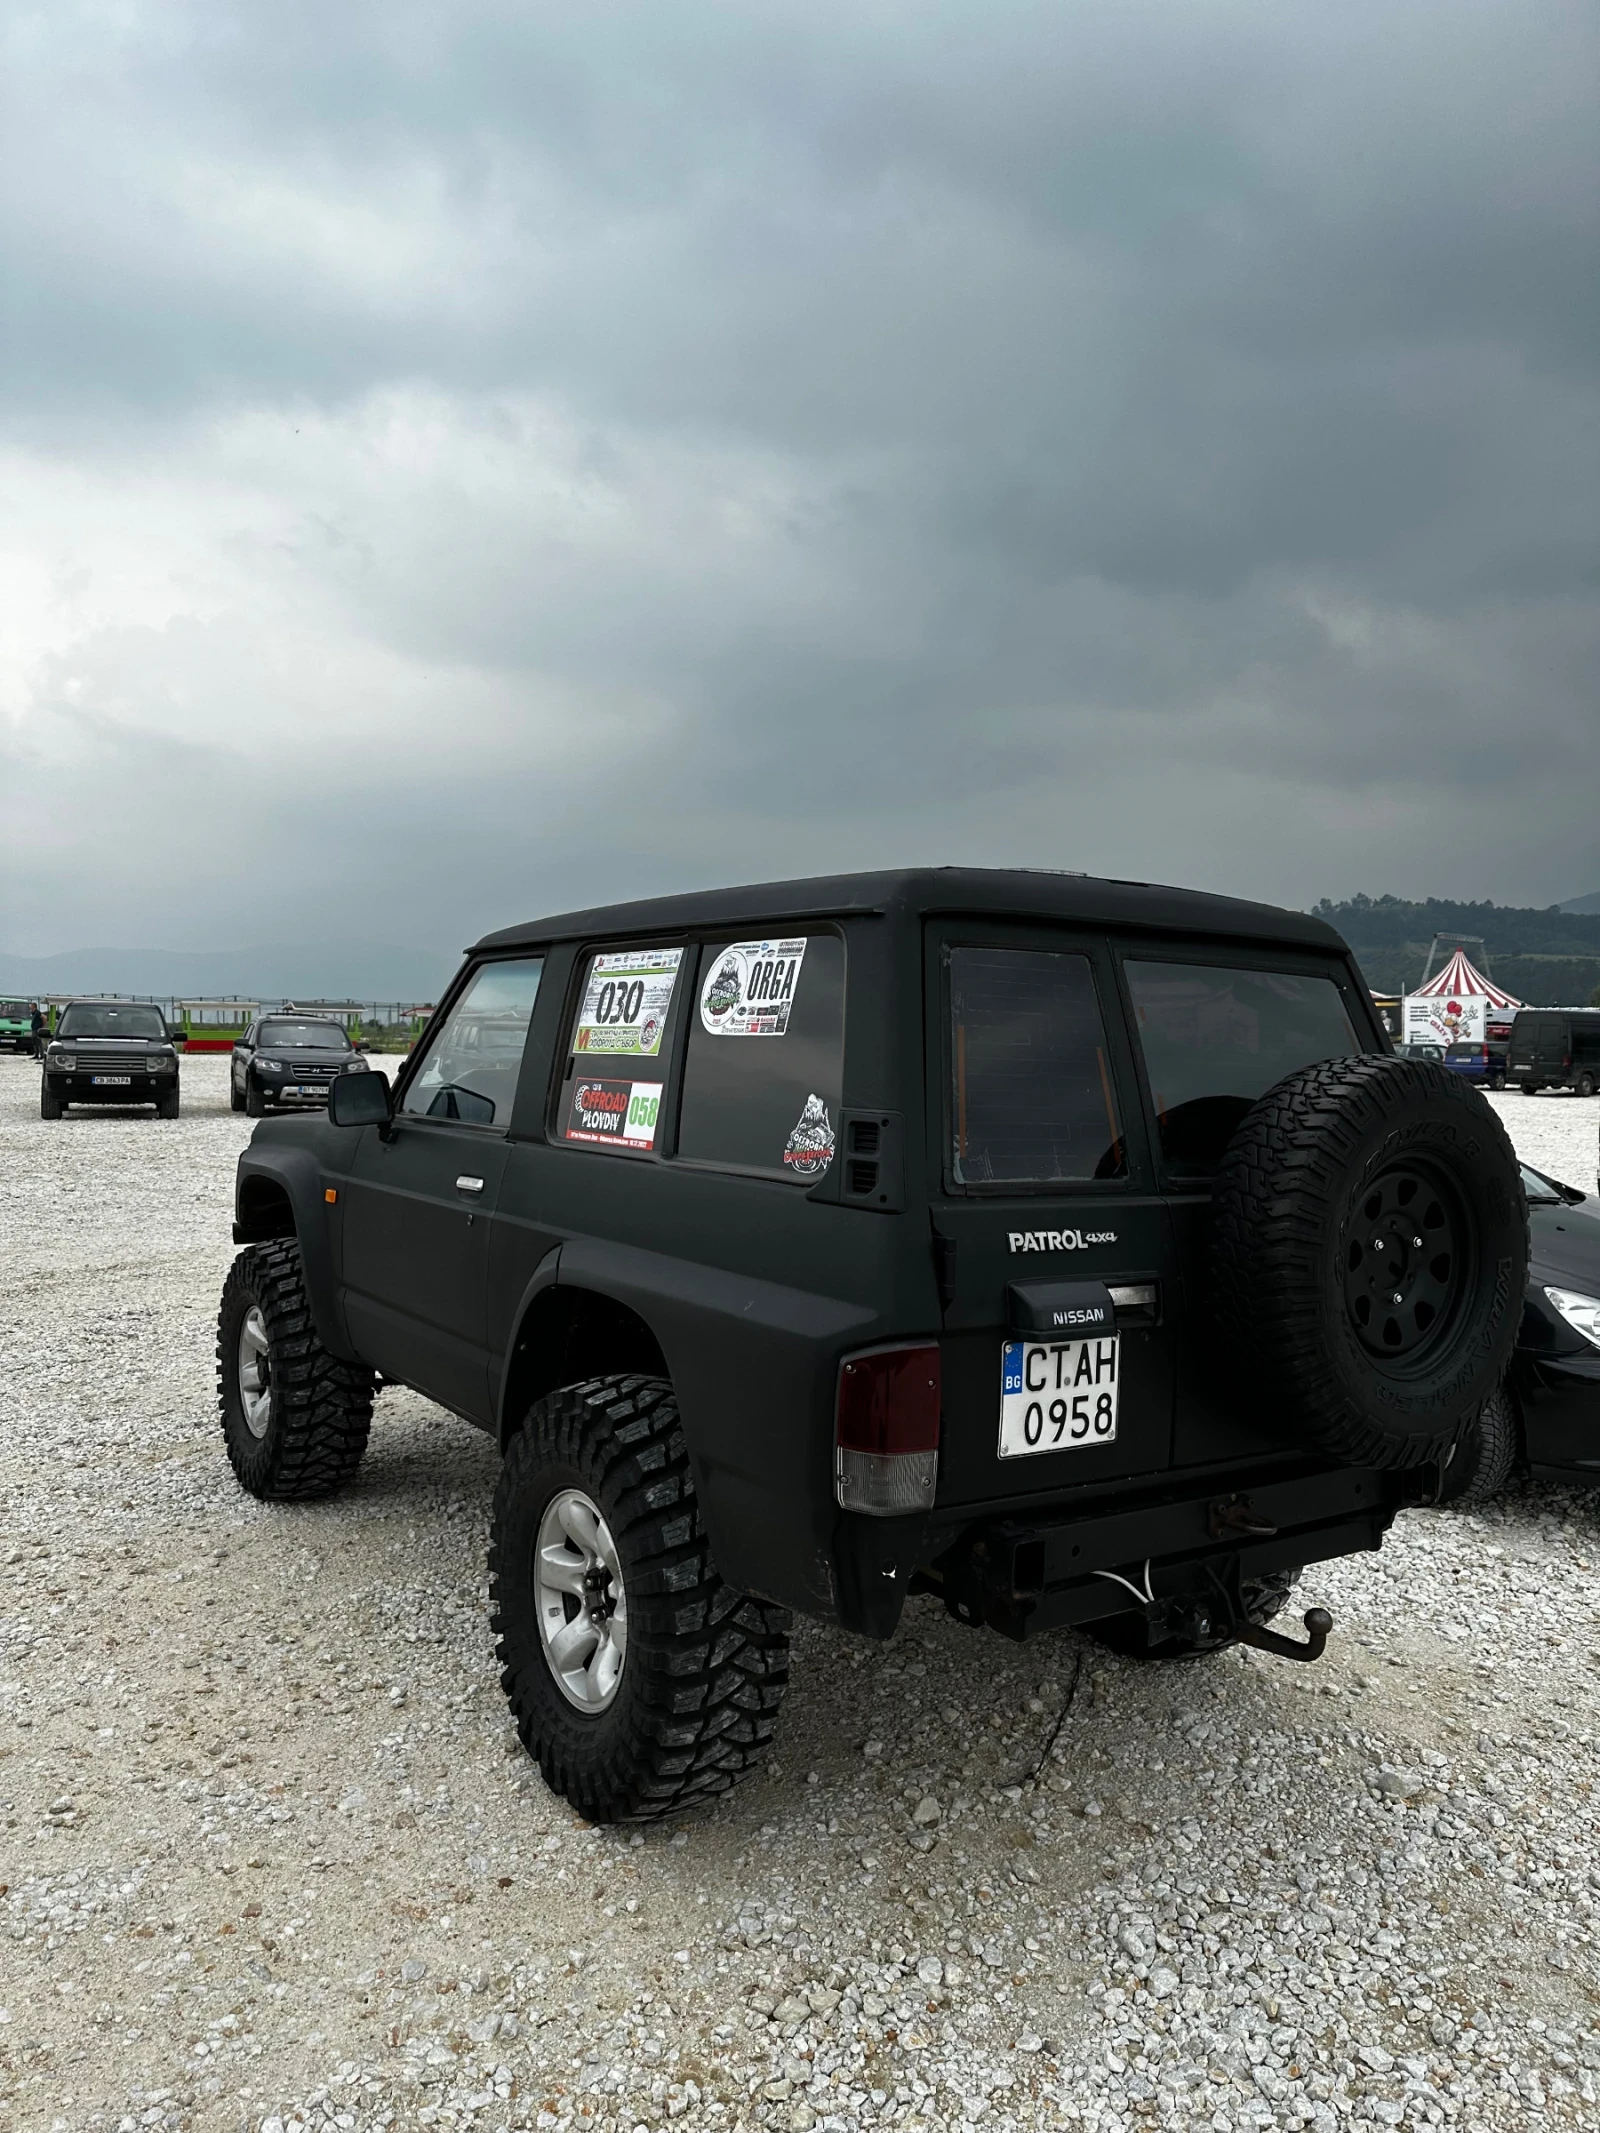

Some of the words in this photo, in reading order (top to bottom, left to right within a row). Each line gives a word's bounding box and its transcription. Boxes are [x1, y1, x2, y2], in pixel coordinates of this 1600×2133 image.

[747, 960, 796, 1001] ORGA
[596, 980, 645, 1024] 030
[1430, 1019, 1448, 1037] CRAZY
[582, 1091, 627, 1112] OFFROAD
[628, 1096, 659, 1128] 058
[582, 1110, 620, 1131] PLOVDIV
[793, 1133, 824, 1151] OFFROAD
[1008, 1229, 1088, 1252] PATROL
[1053, 1308, 1104, 1325] NISSAN
[1005, 1375, 1021, 1390] BG
[1024, 1392, 1113, 1446] 0958
